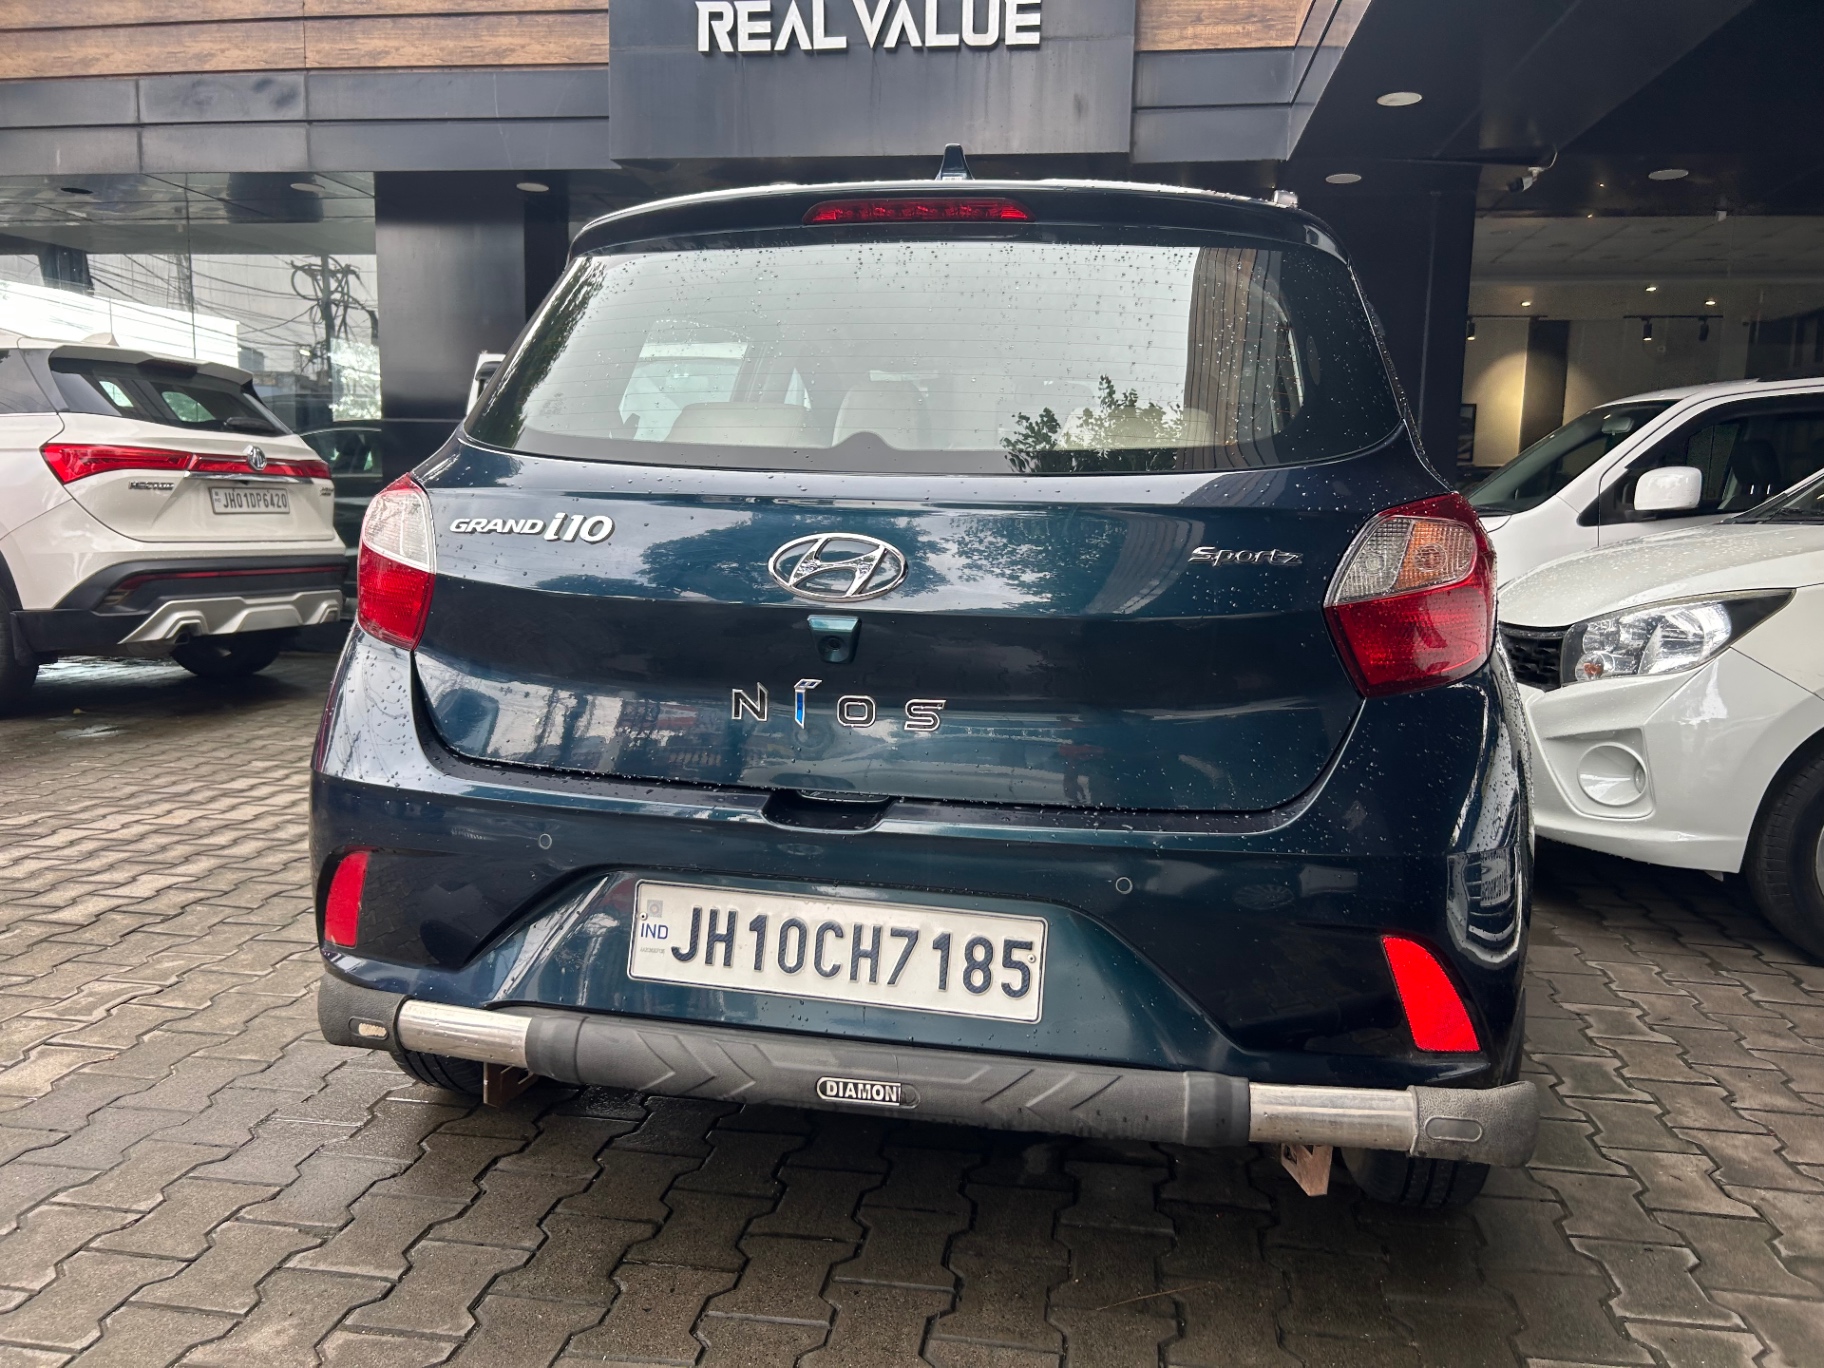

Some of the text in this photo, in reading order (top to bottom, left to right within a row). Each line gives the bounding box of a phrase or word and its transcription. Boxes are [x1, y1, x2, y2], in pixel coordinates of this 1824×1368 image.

[696, 0, 1041, 52] REAL VALUE
[450, 512, 616, 544] GRAND i10
[1188, 546, 1303, 567] Sportz
[640, 922, 669, 940] IND
[671, 906, 1034, 999] JH10CH7185
[826, 1080, 901, 1102] DIAMON
